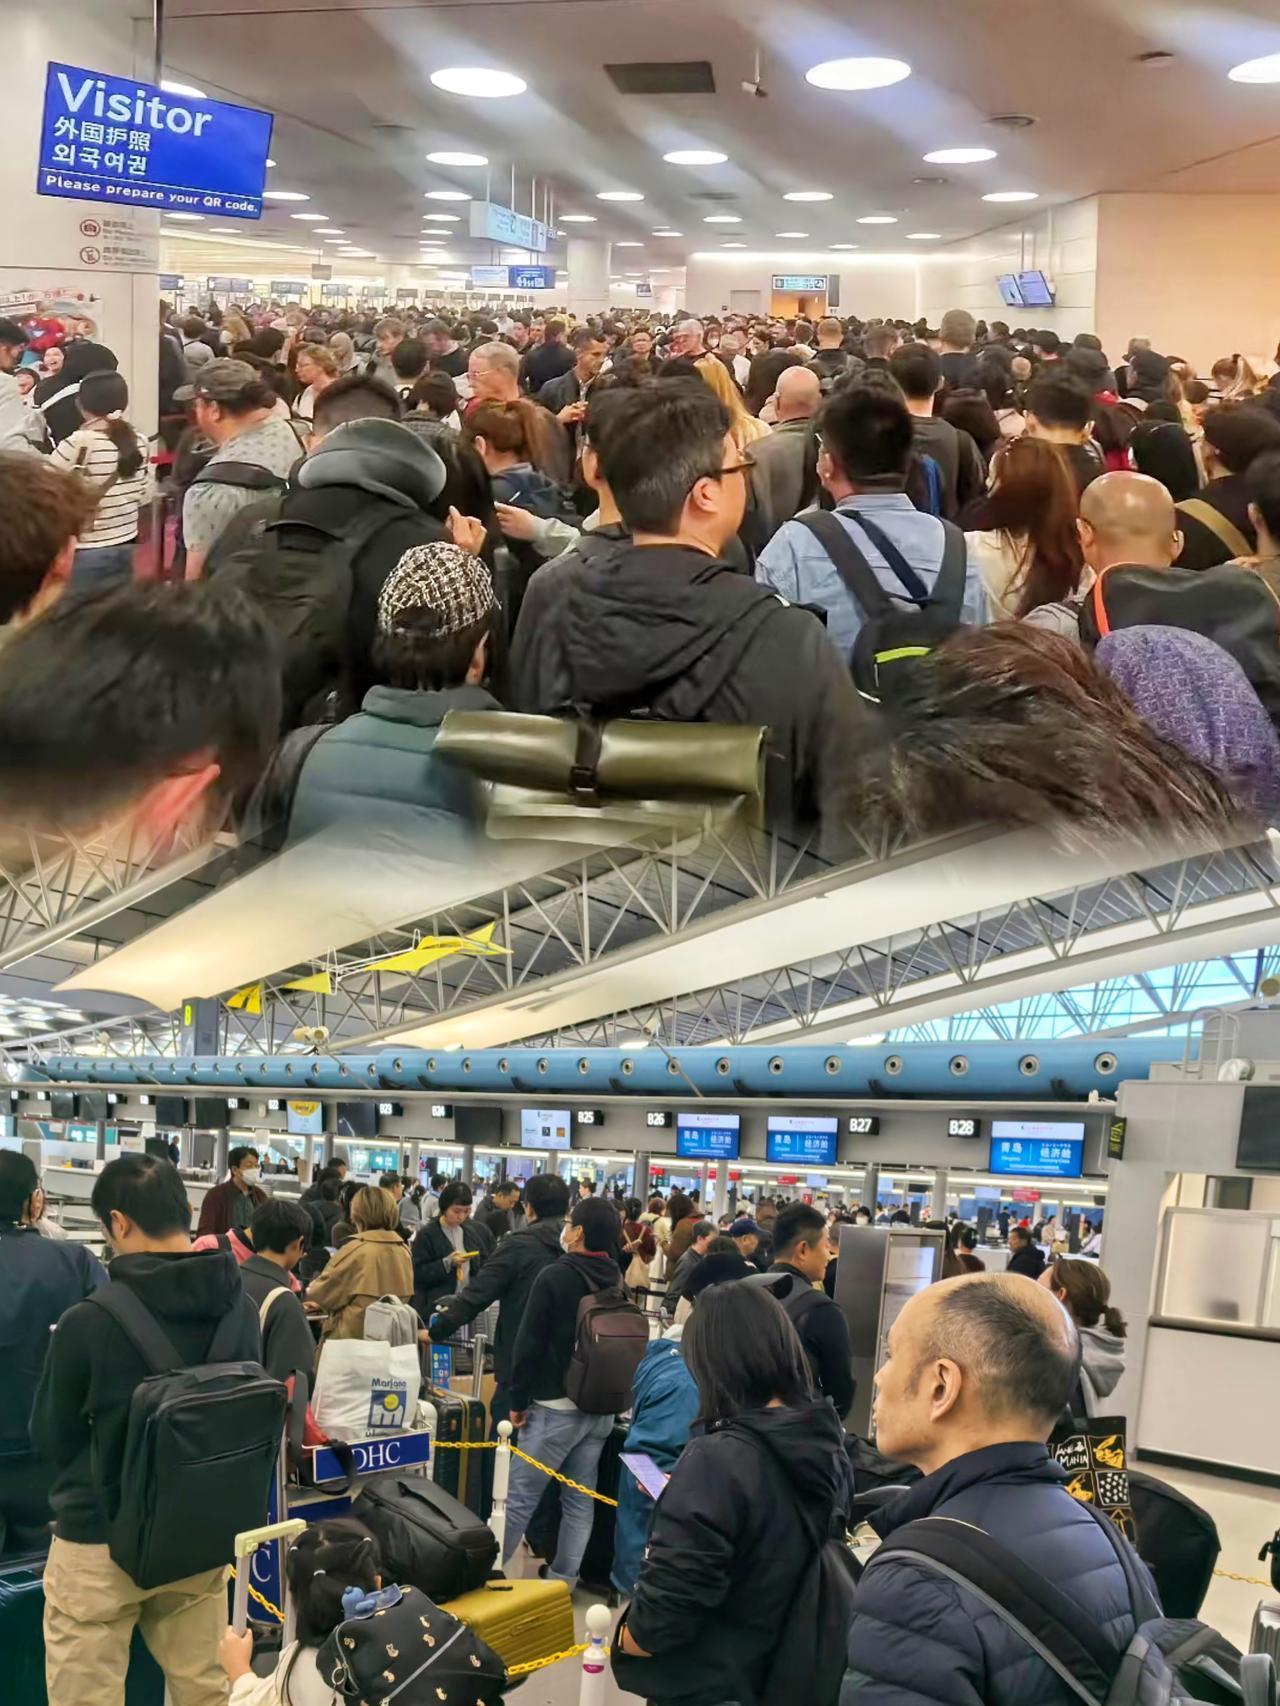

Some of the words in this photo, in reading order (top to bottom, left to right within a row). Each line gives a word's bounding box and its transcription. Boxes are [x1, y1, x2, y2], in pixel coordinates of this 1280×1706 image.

[57, 72, 213, 137] Visitor
[54, 116, 151, 152] 外国护照
[52, 143, 147, 175] 외국여권
[46, 176, 100, 191] Please
[106, 184, 164, 200] prepare
[169, 192, 199, 205] your
[203, 196, 221, 207] QR
[225, 200, 258, 212] code.
[577, 1111, 594, 1124] B25
[647, 1112, 665, 1126] B26
[849, 1117, 872, 1133] B27
[949, 1120, 974, 1135] B28
[352, 1441, 401, 1470] DHC
